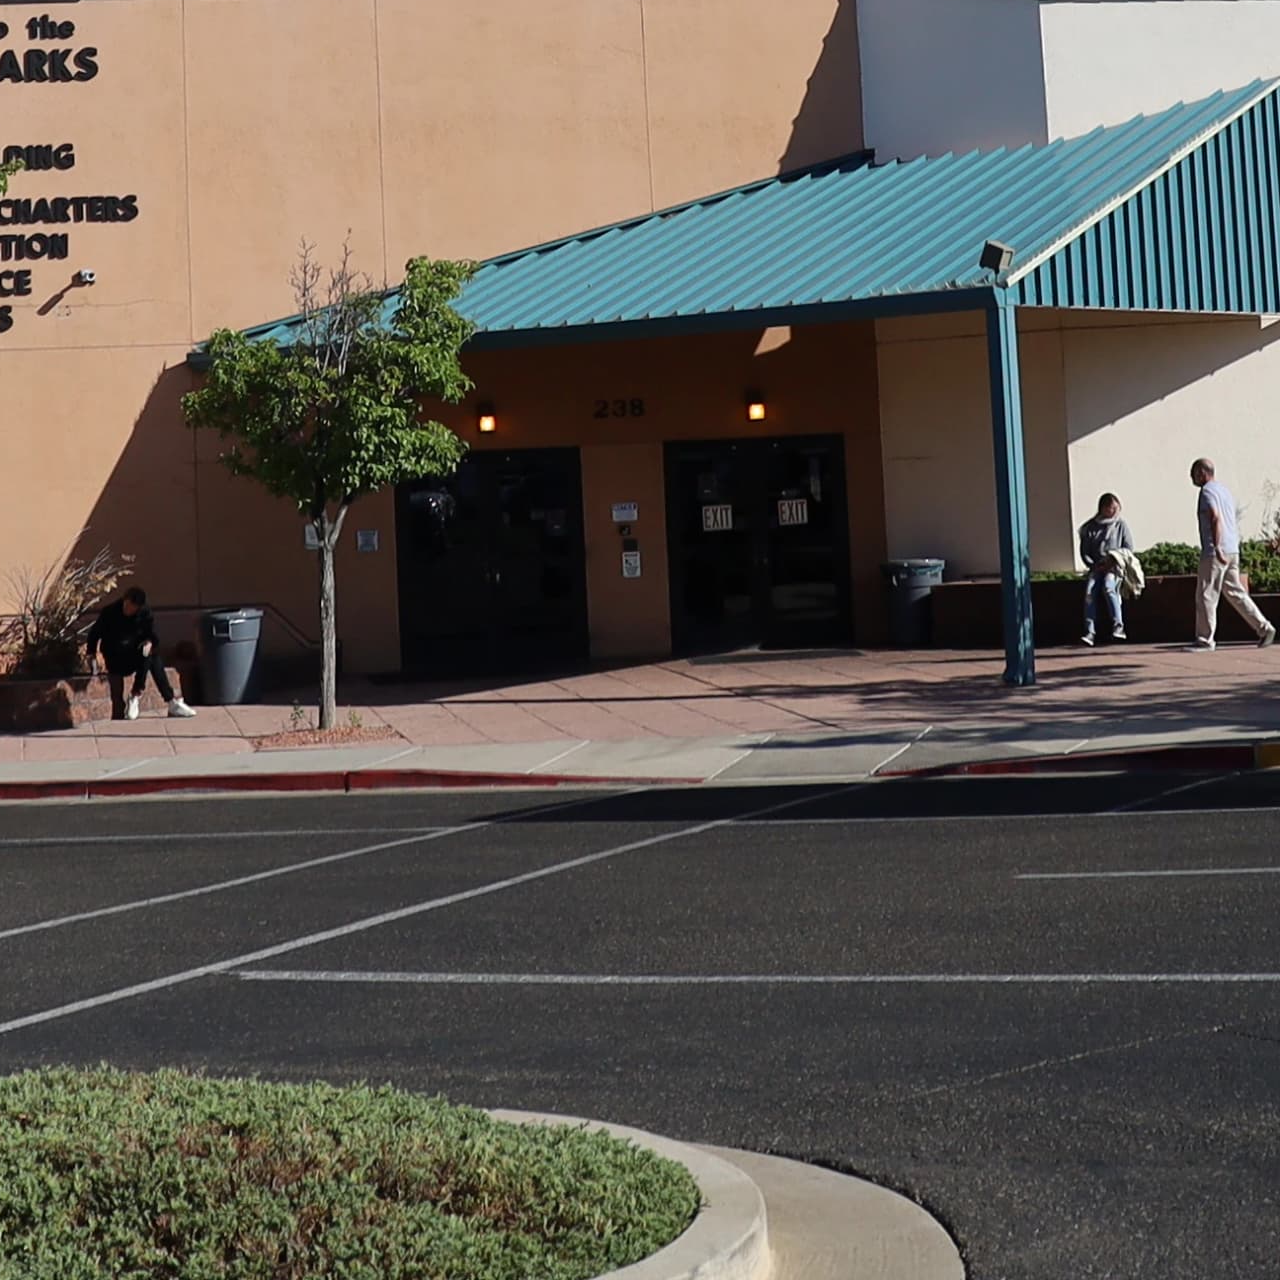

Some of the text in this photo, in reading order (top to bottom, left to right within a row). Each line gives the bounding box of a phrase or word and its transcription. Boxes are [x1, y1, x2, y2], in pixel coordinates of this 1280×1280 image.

[25, 14, 75, 40] the
[592, 399, 644, 419] 238
[703, 506, 730, 528] EXIT
[780, 500, 806, 523] EXIT
